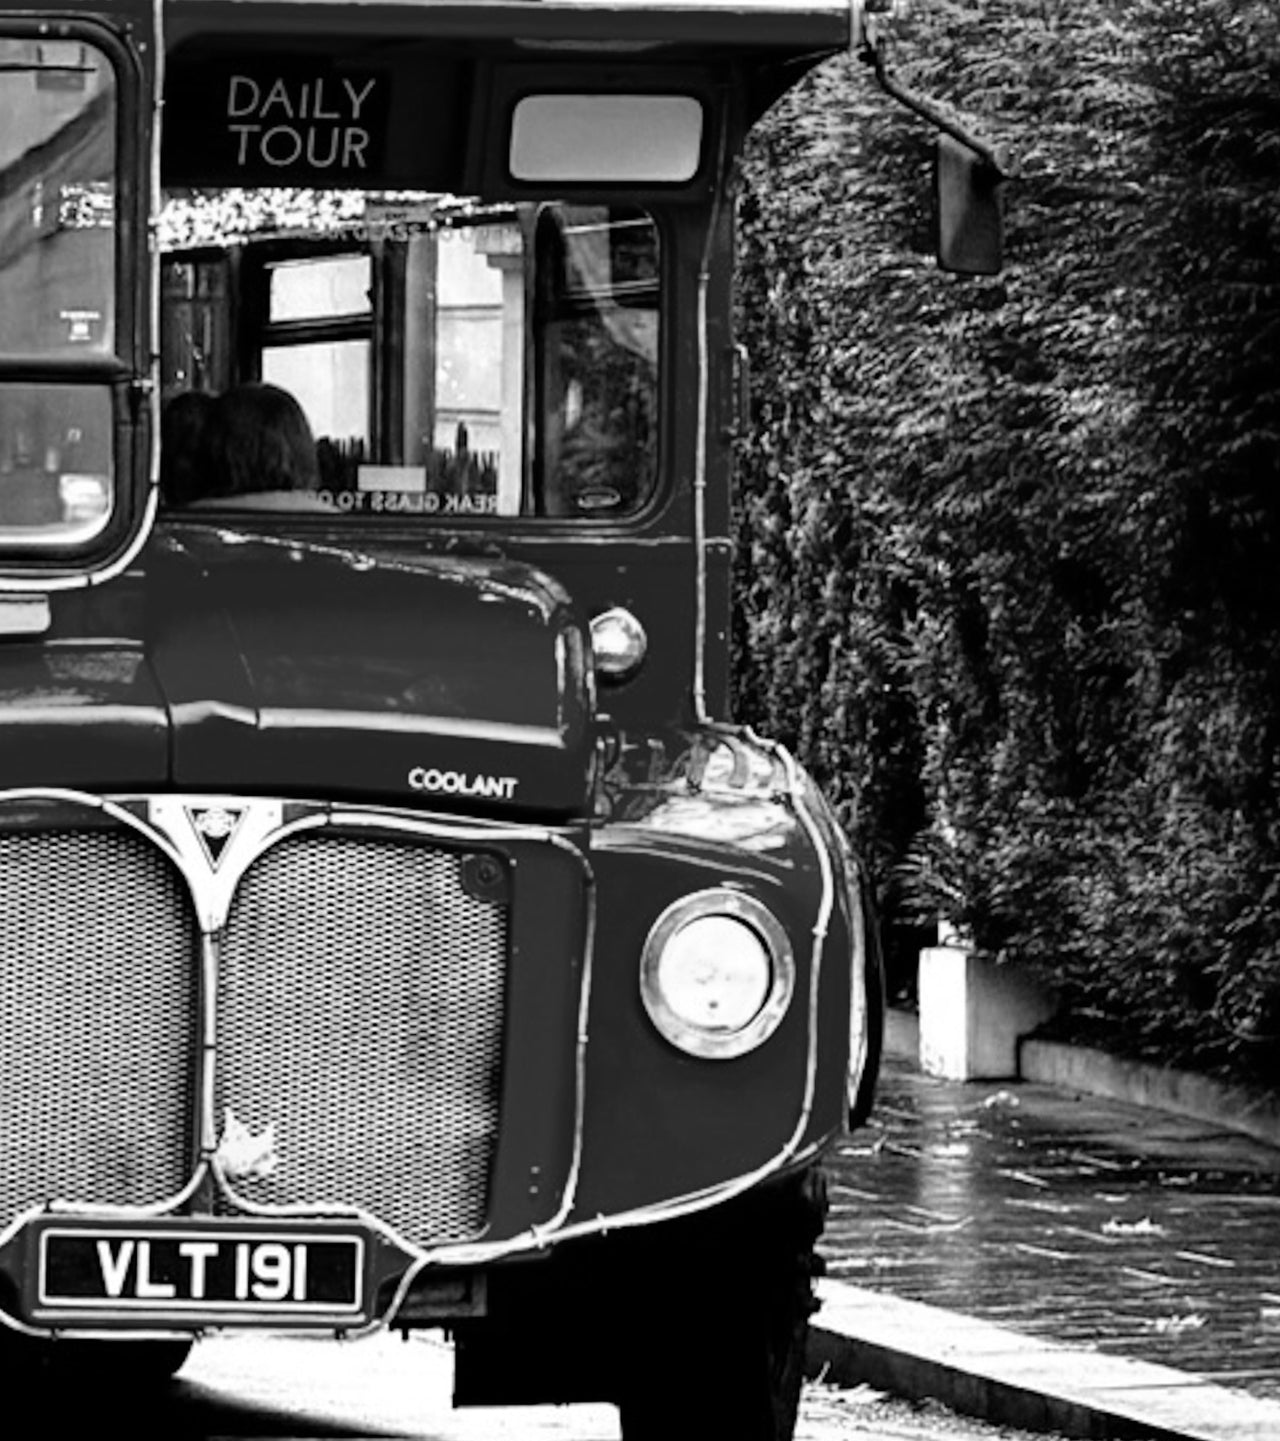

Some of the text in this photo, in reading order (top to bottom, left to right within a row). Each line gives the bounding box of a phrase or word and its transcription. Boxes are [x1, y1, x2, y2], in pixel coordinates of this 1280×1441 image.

[227, 75, 376, 120] DAILY
[228, 124, 370, 168] TOUR
[408, 767, 519, 799] COOLANT
[96, 1240, 307, 1301] VLT 191
